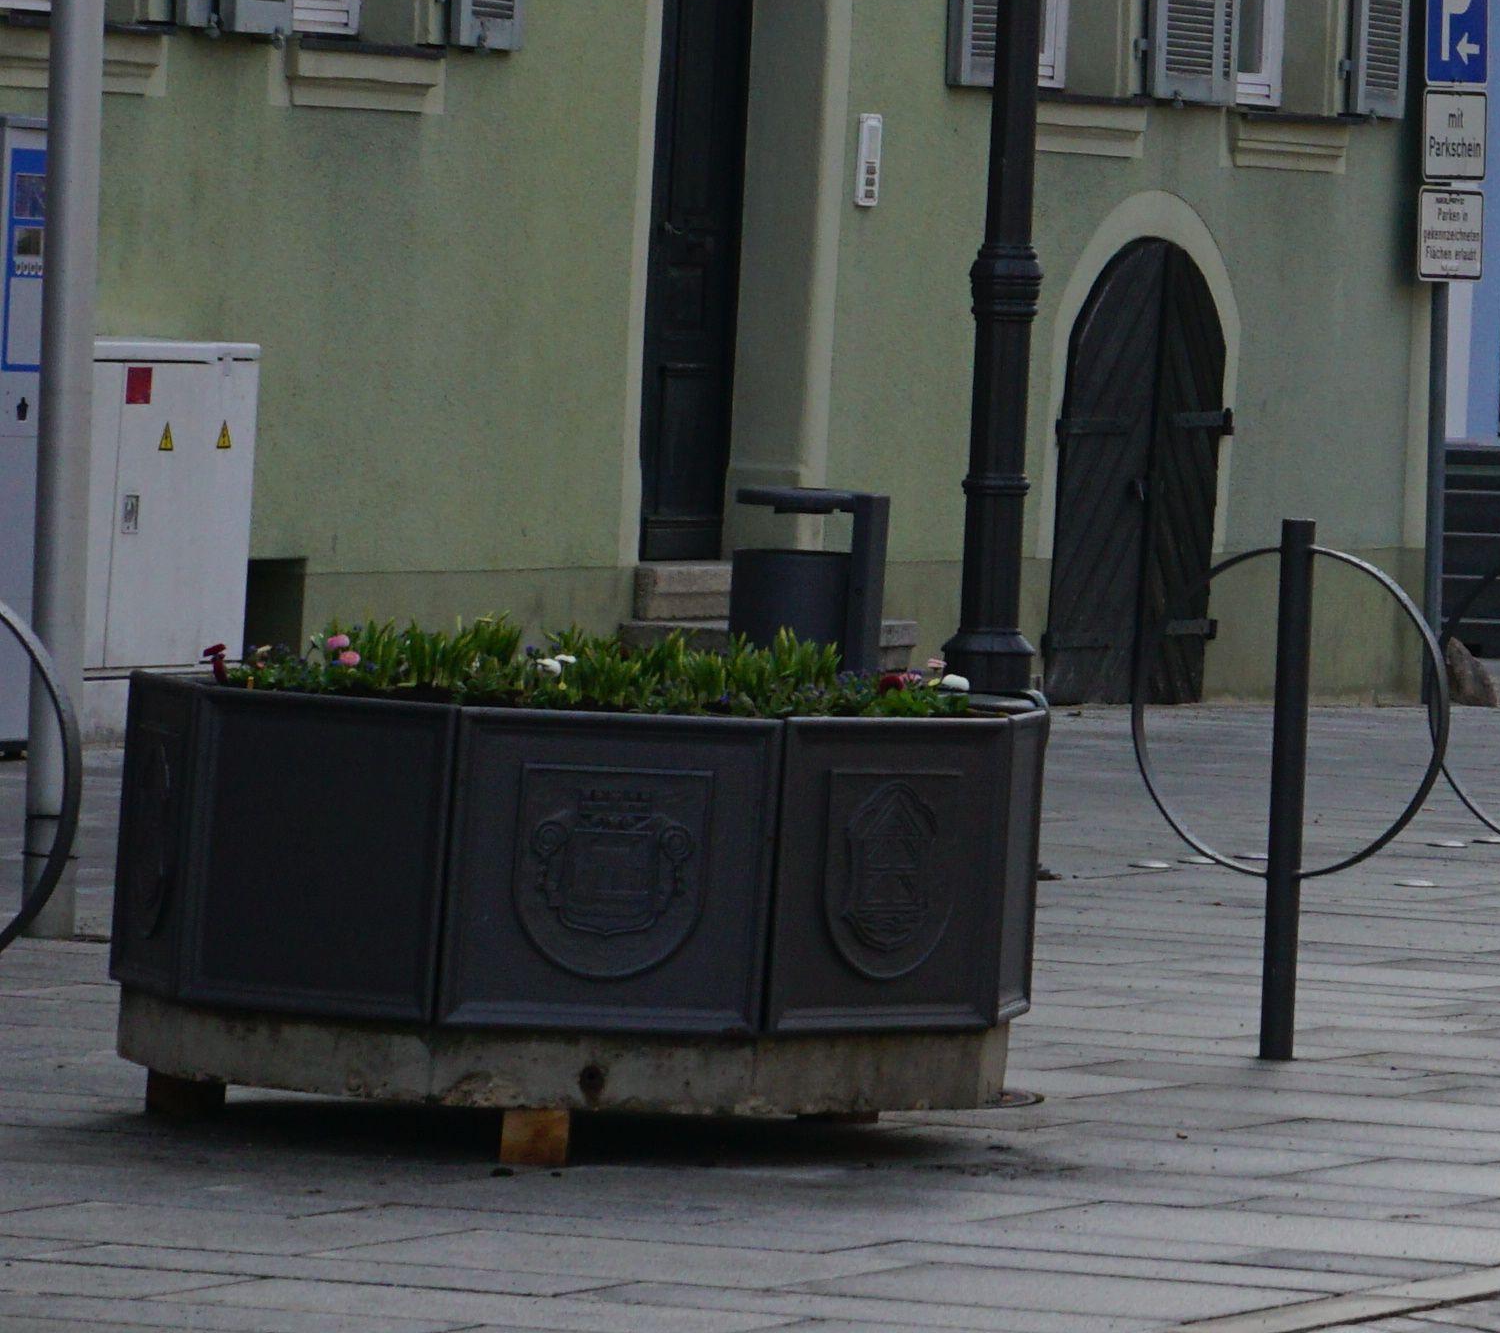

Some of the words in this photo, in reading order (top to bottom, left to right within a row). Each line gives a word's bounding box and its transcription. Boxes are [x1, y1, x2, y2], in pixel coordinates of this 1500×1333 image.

[1448, 107, 1464, 129] mit
[1429, 136, 1482, 158] Parkschein
[1437, 208, 1460, 222] Parken
